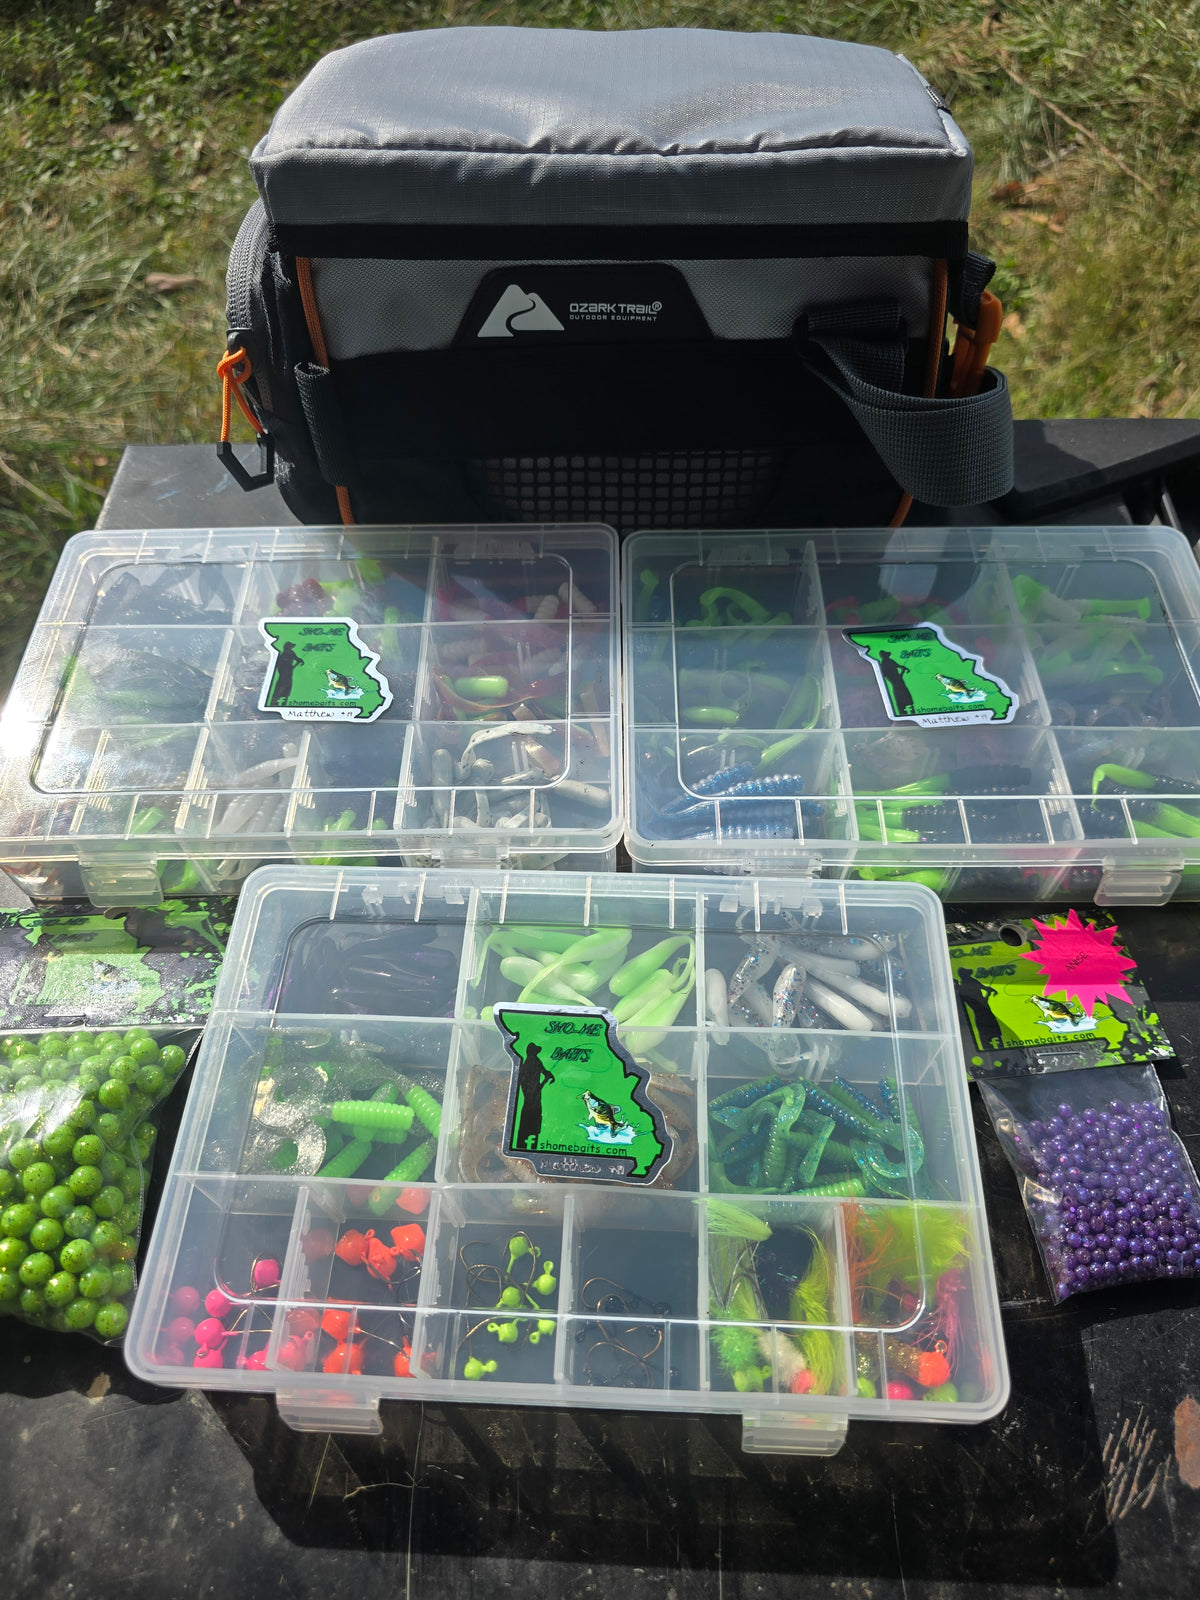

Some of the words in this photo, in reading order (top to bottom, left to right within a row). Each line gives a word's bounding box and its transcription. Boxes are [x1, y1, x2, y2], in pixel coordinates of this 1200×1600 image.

[900, 648, 932, 660] BAITS
[287, 709, 335, 718] Matthew
[922, 714, 970, 725] Matthew
[550, 1047, 593, 1062] BAITS
